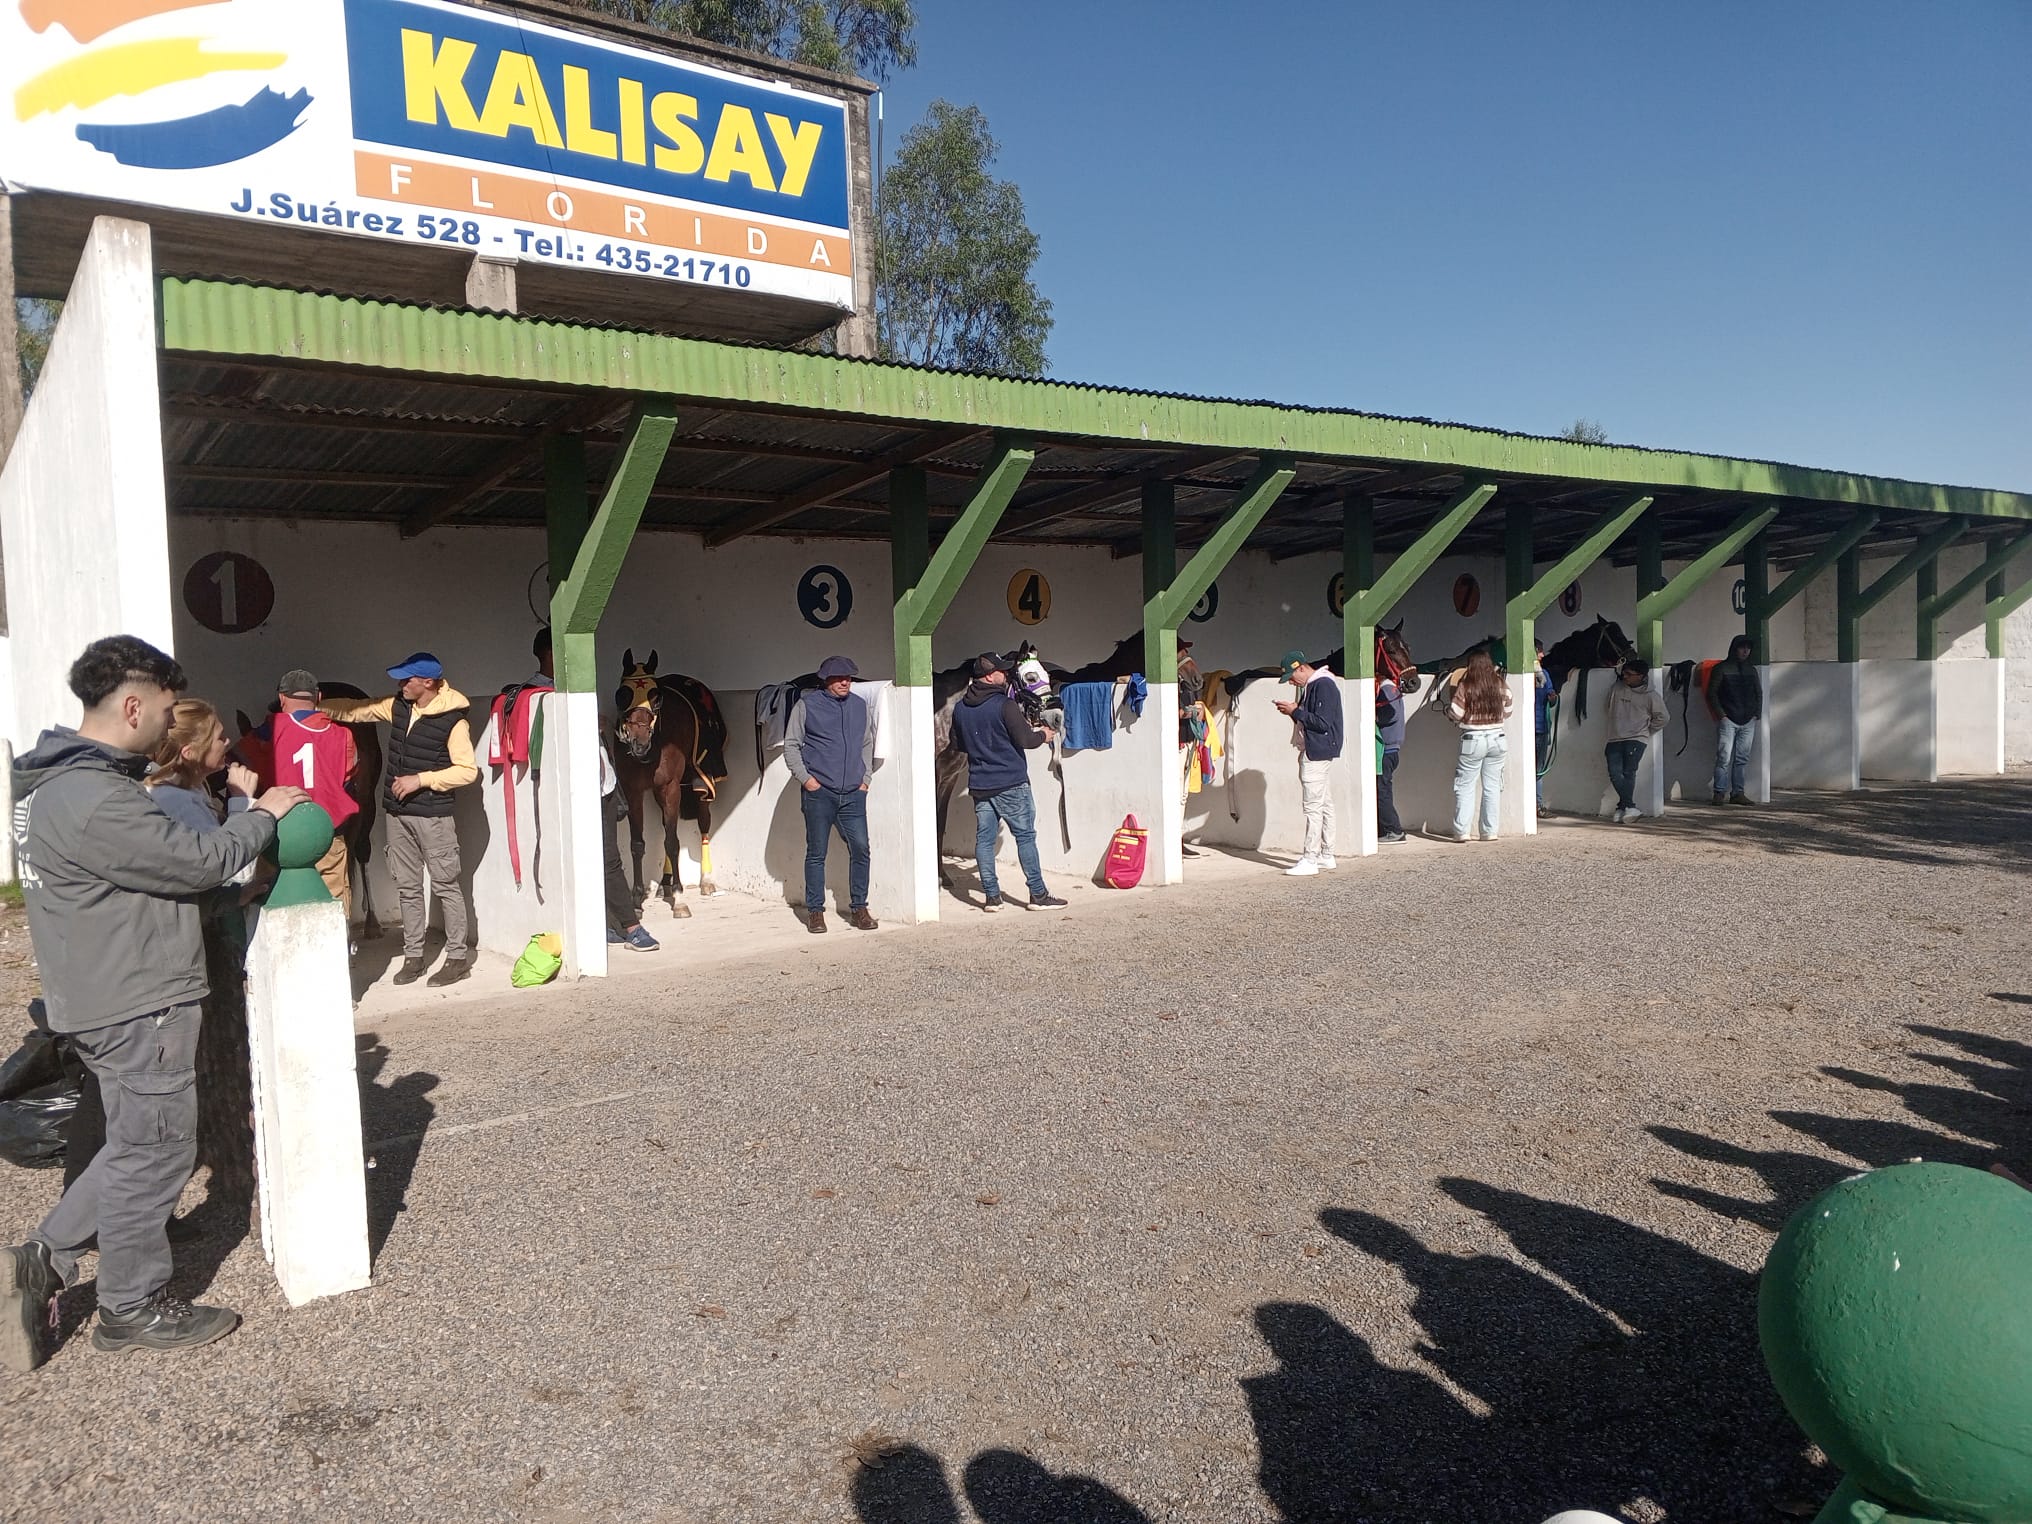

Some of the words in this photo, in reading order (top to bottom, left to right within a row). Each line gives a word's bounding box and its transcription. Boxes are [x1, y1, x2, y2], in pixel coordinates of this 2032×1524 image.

[401, 28, 824, 198] KALISAY
[230, 187, 404, 236] J.Suárez
[416, 213, 481, 246] 528
[513, 228, 585, 262] Tel.:
[595, 243, 751, 288] 435-21710
[389, 163, 833, 267] FLORIDA
[209, 559, 238, 625] 1
[810, 571, 839, 622] 3
[1018, 574, 1042, 620] 4
[1460, 574, 1477, 612] 7
[1565, 580, 1577, 613] 8
[292, 742, 315, 789] 1
